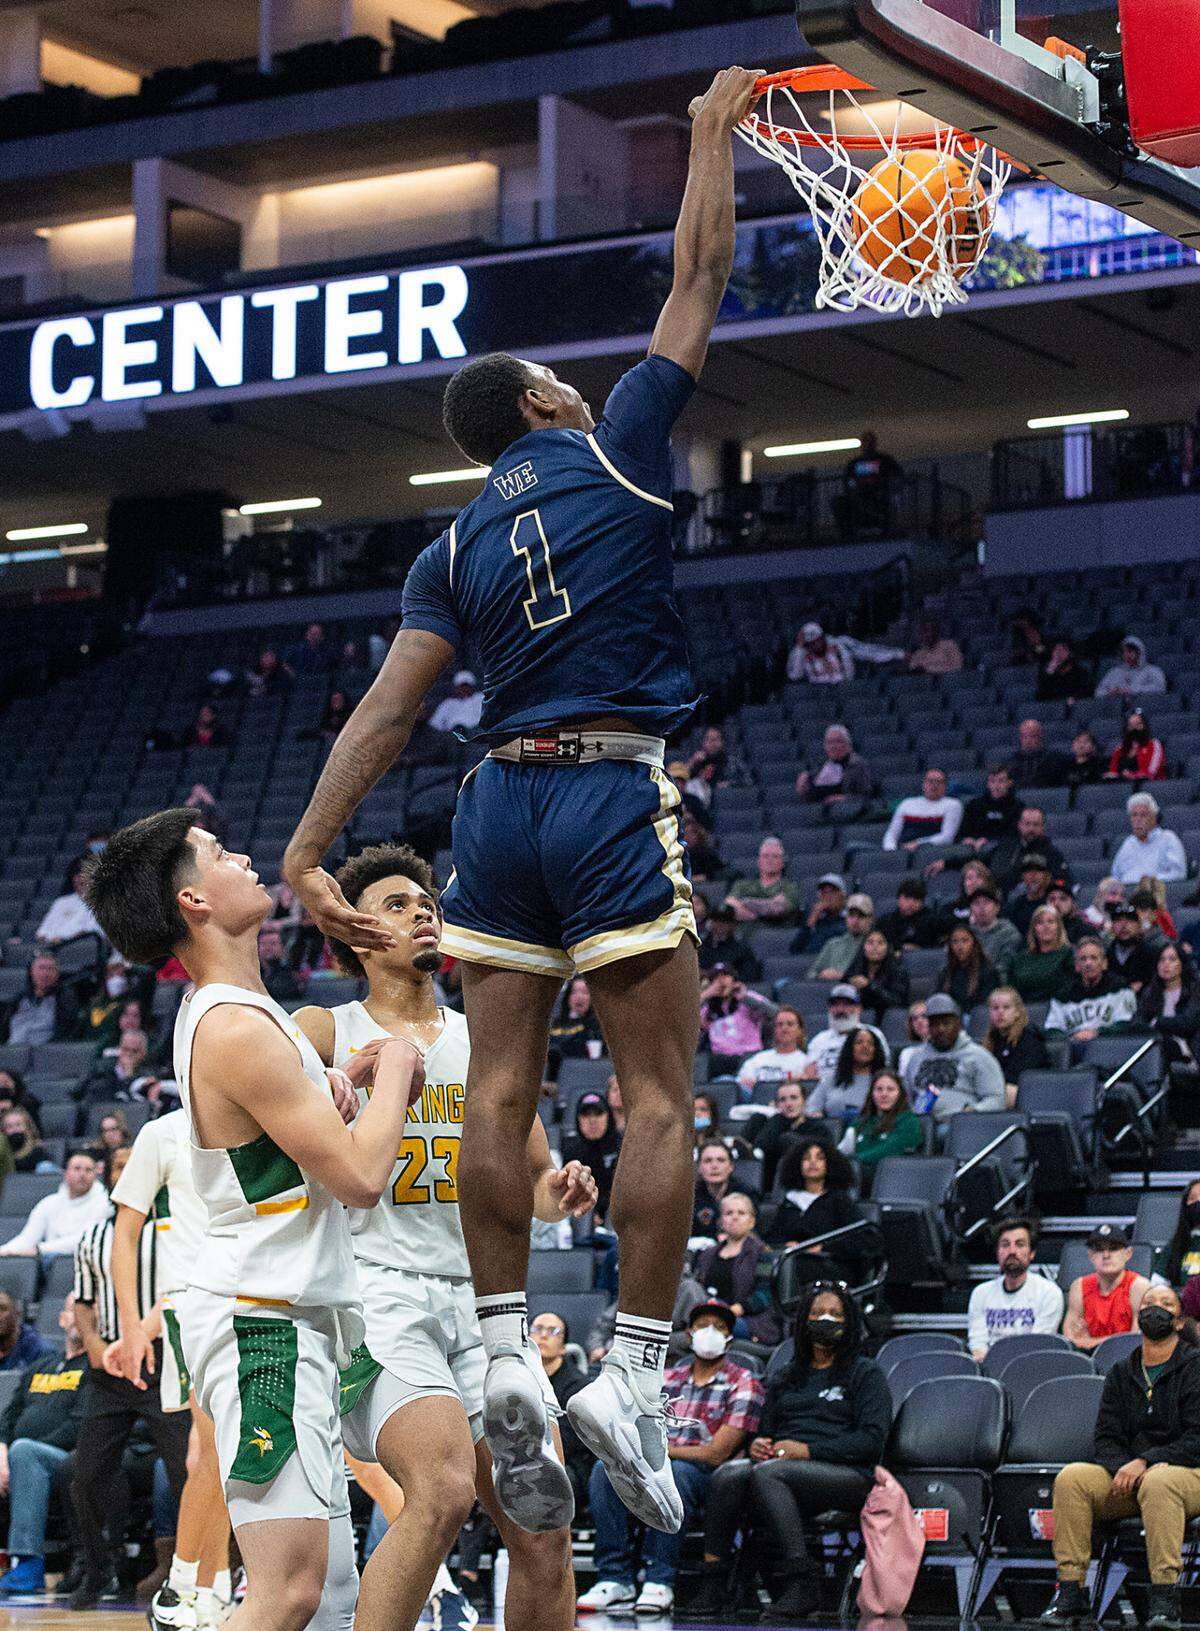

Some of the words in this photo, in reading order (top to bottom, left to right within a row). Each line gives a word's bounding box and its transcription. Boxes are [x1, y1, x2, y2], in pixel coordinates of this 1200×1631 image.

[30, 265, 469, 410] CENTER
[493, 461, 538, 500] WE
[510, 509, 571, 630] 1
[392, 1135, 462, 1206] 23
